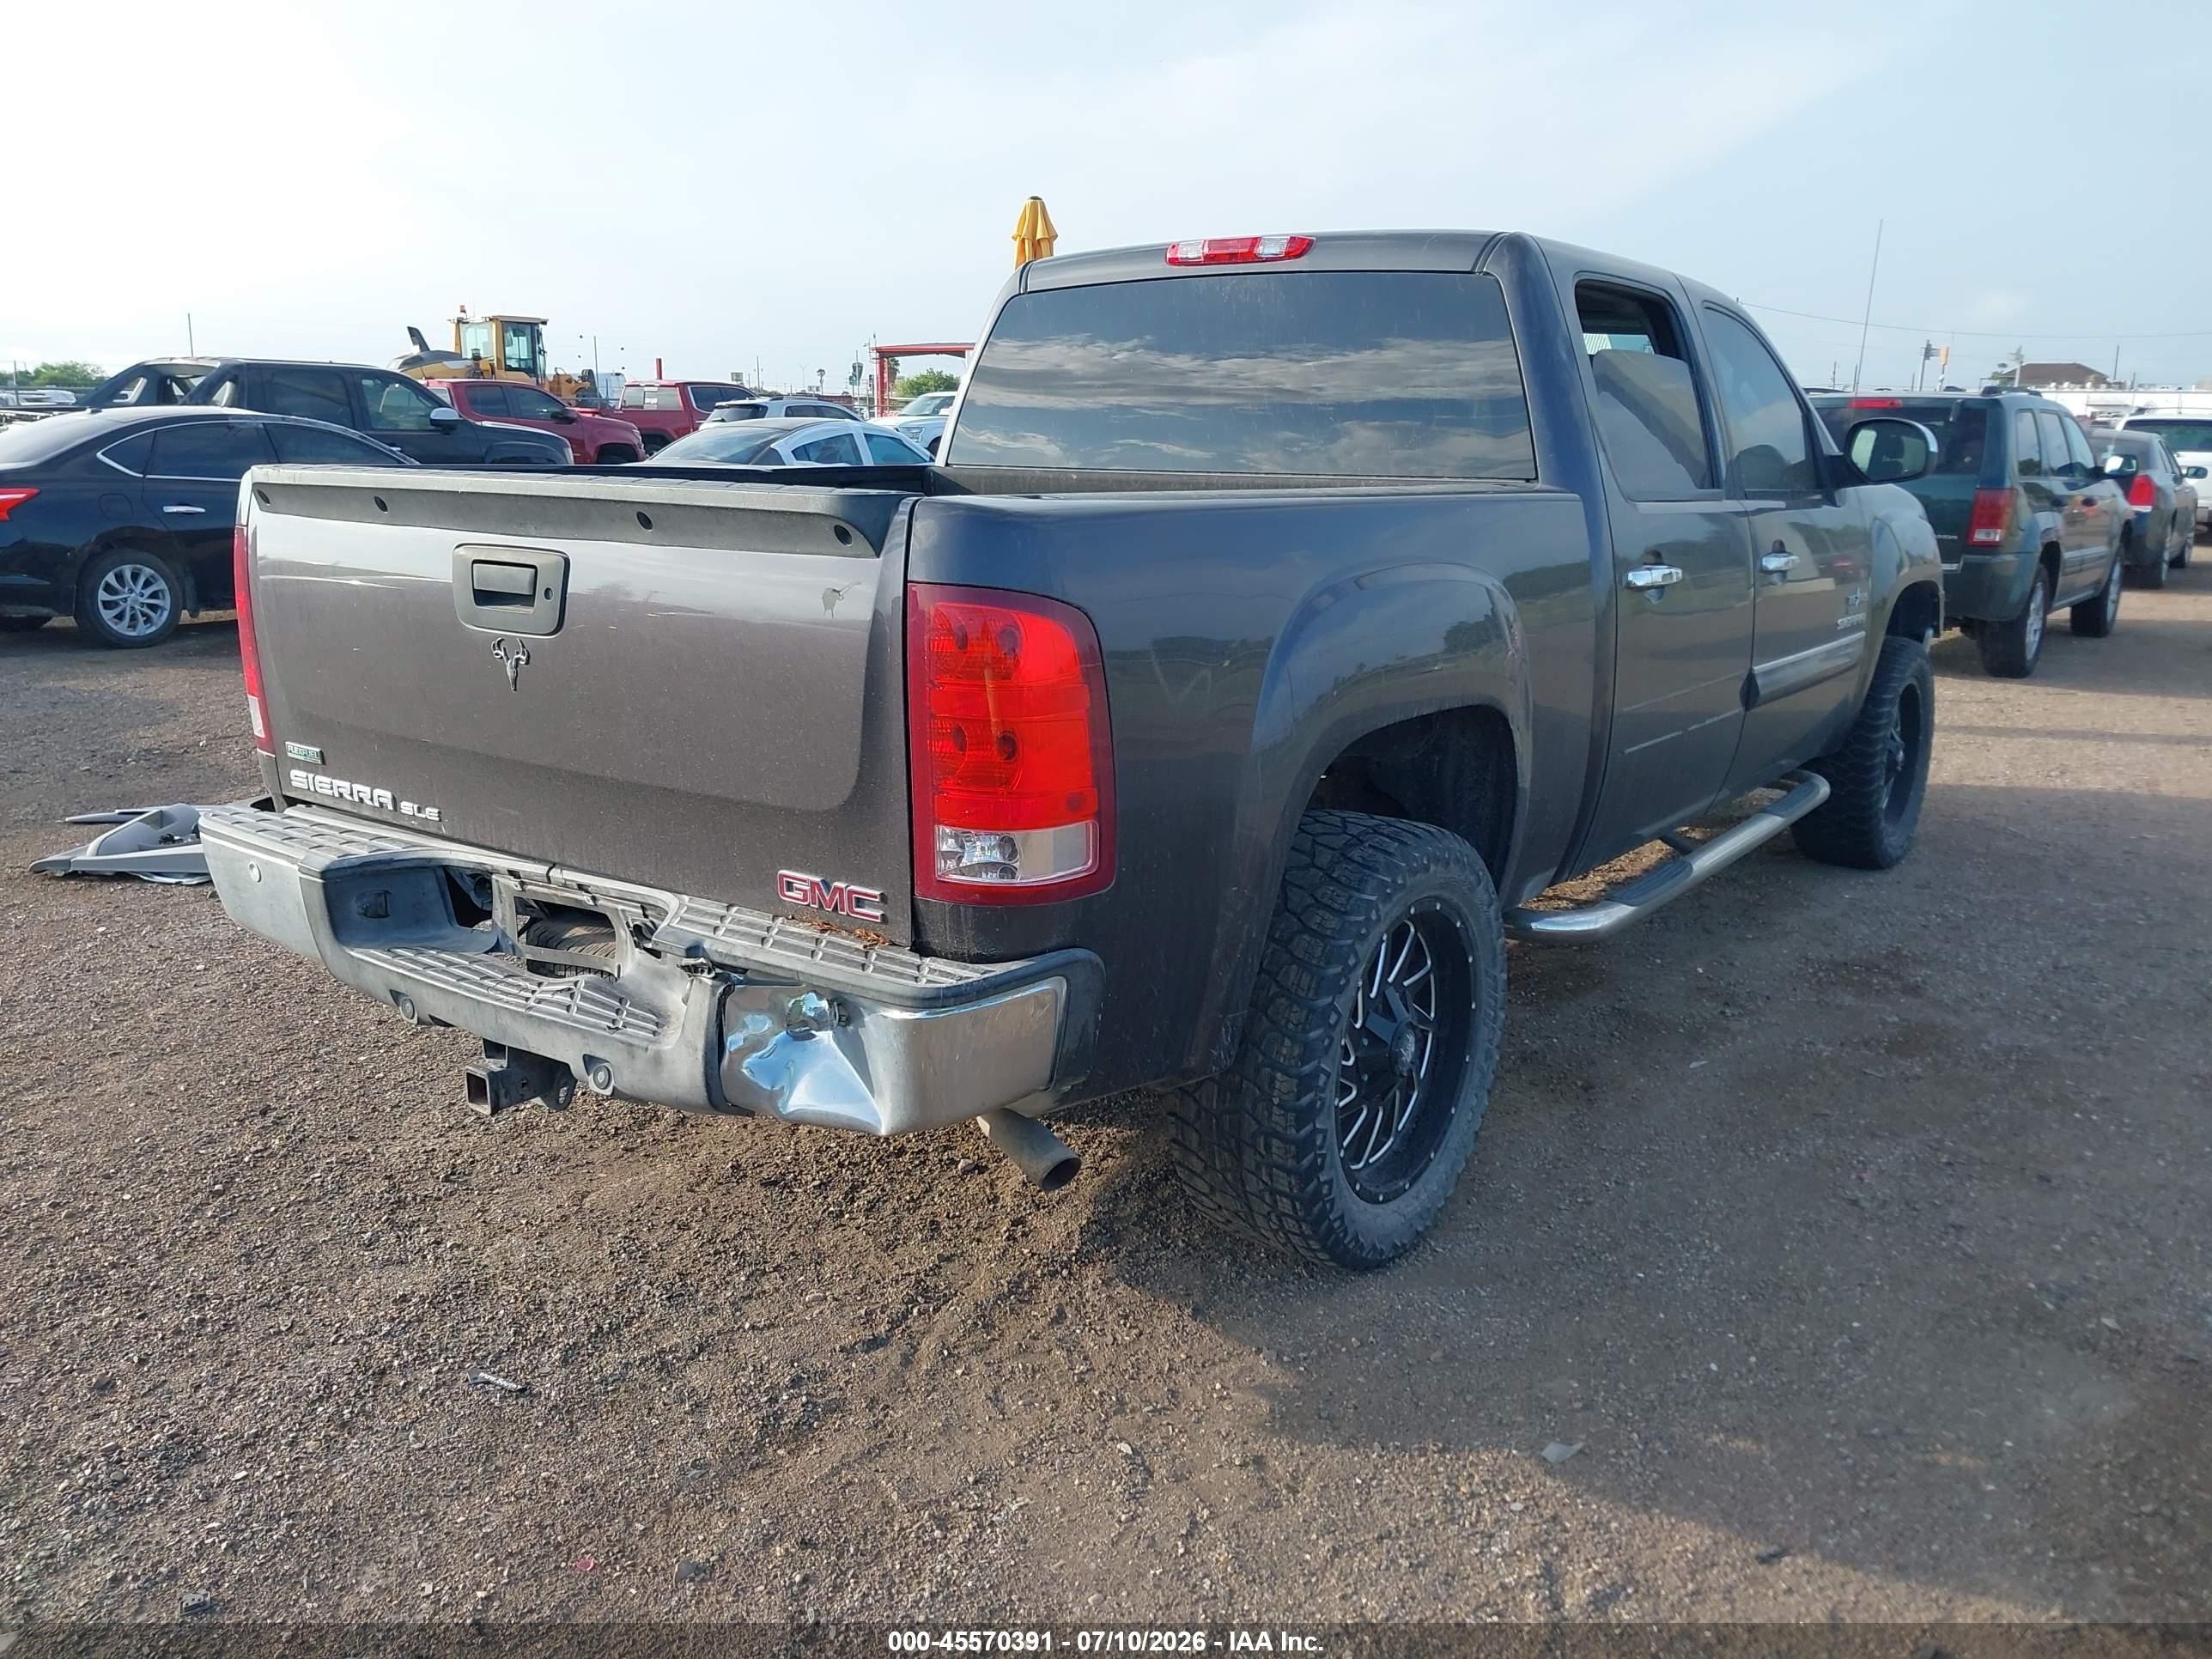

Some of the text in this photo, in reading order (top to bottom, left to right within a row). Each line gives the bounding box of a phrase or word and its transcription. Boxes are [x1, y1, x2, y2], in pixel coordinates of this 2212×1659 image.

[289, 769, 441, 822] SIERRA SLE
[777, 869, 886, 923] GMC
